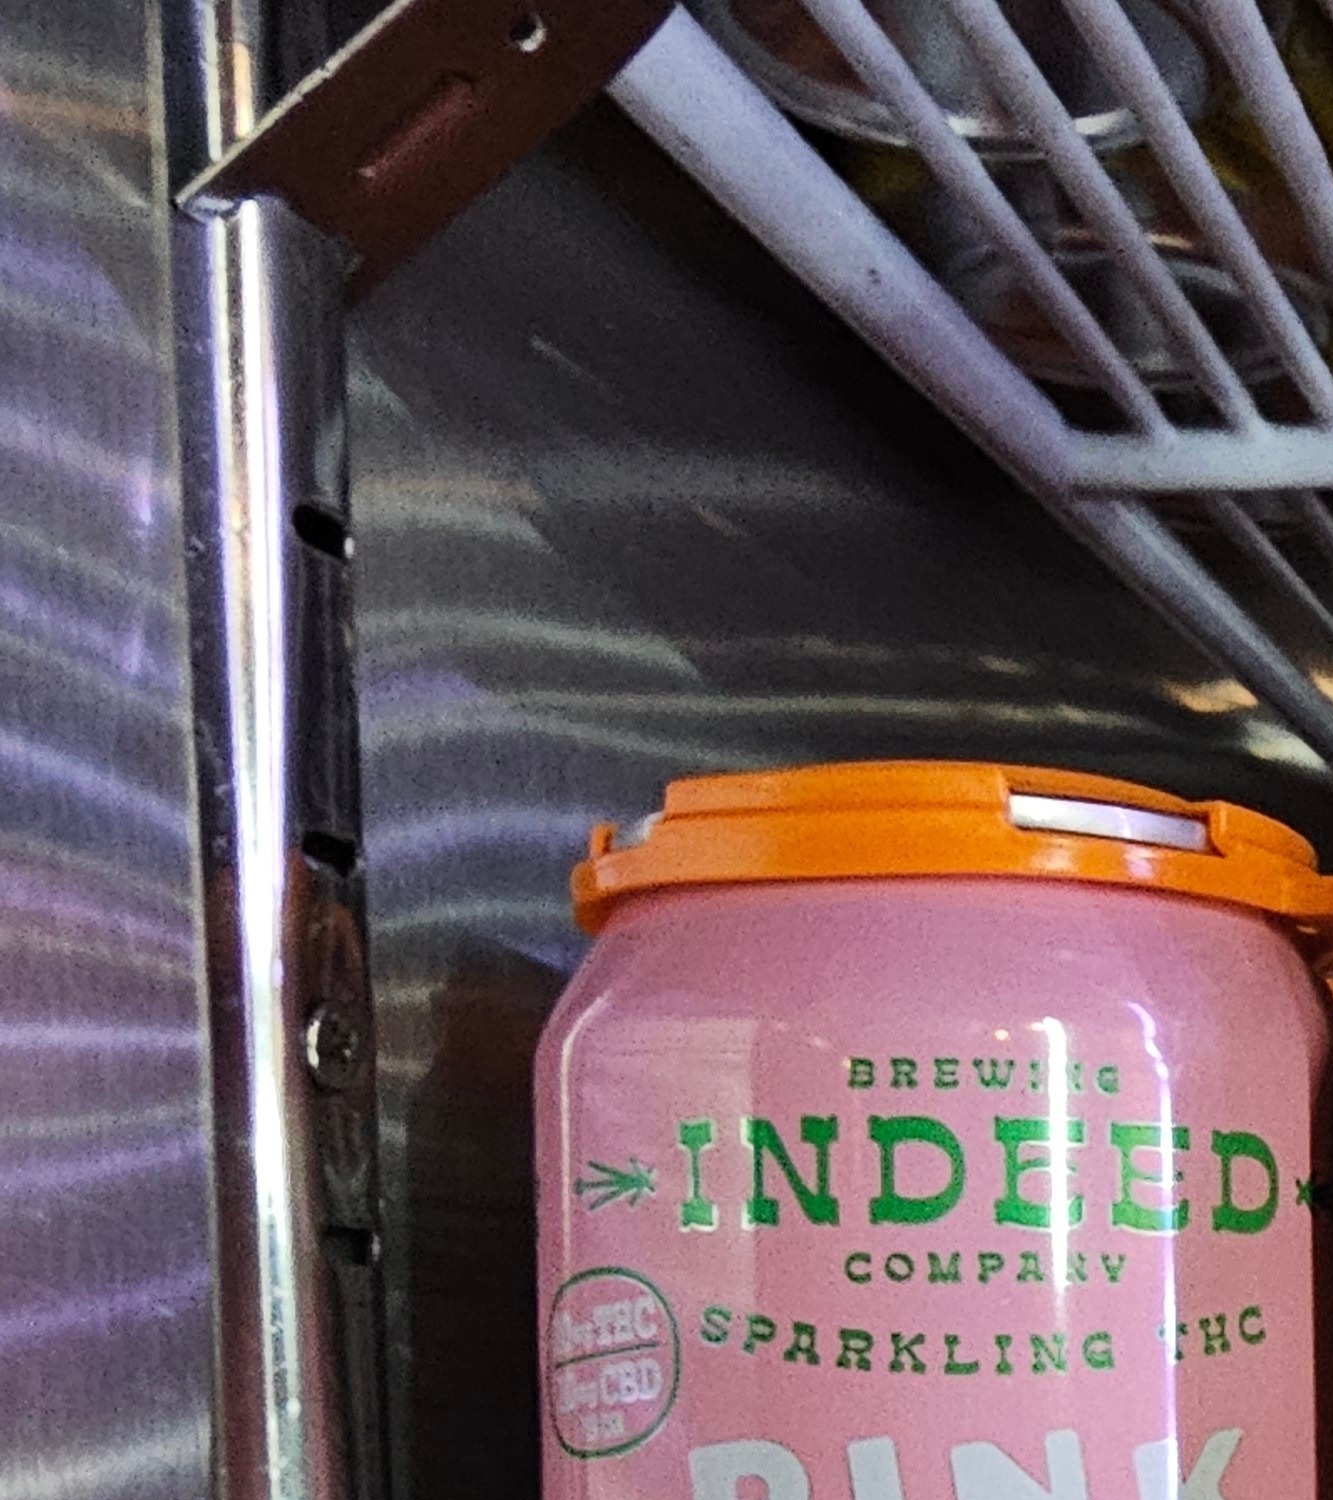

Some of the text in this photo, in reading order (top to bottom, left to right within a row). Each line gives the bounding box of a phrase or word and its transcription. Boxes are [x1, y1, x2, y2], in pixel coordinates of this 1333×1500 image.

[847, 1057, 1122, 1094] BREWING
[677, 1114, 1280, 1236] INDEED
[844, 1252, 1127, 1284] COMPANY
[699, 1305, 1268, 1376] SPARKLING THC
